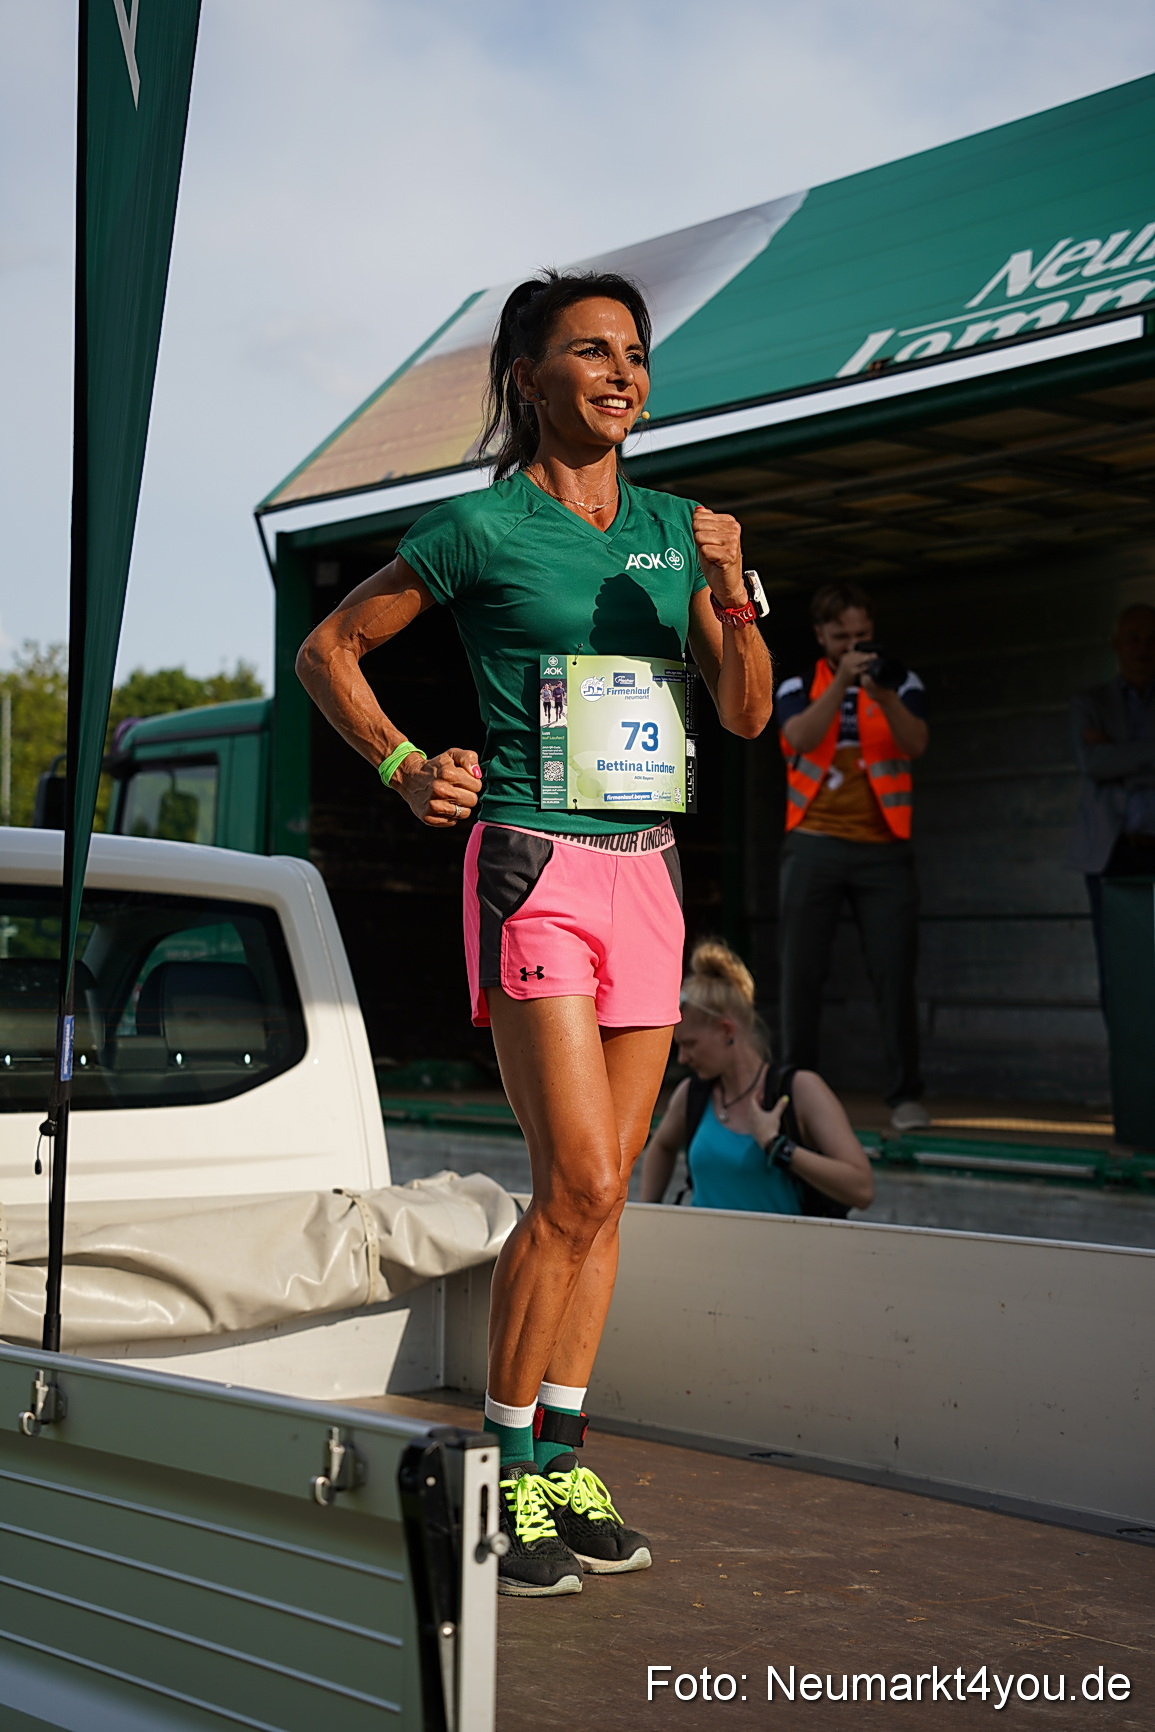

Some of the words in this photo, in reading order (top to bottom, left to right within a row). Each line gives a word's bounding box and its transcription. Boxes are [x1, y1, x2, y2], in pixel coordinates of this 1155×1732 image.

[625, 553, 667, 570] AOK
[543, 667, 563, 675] AOK
[606, 686, 650, 696] Firmenlauf
[621, 721, 659, 752] 73
[596, 759, 643, 772] Bettina
[645, 760, 675, 774] Lindner
